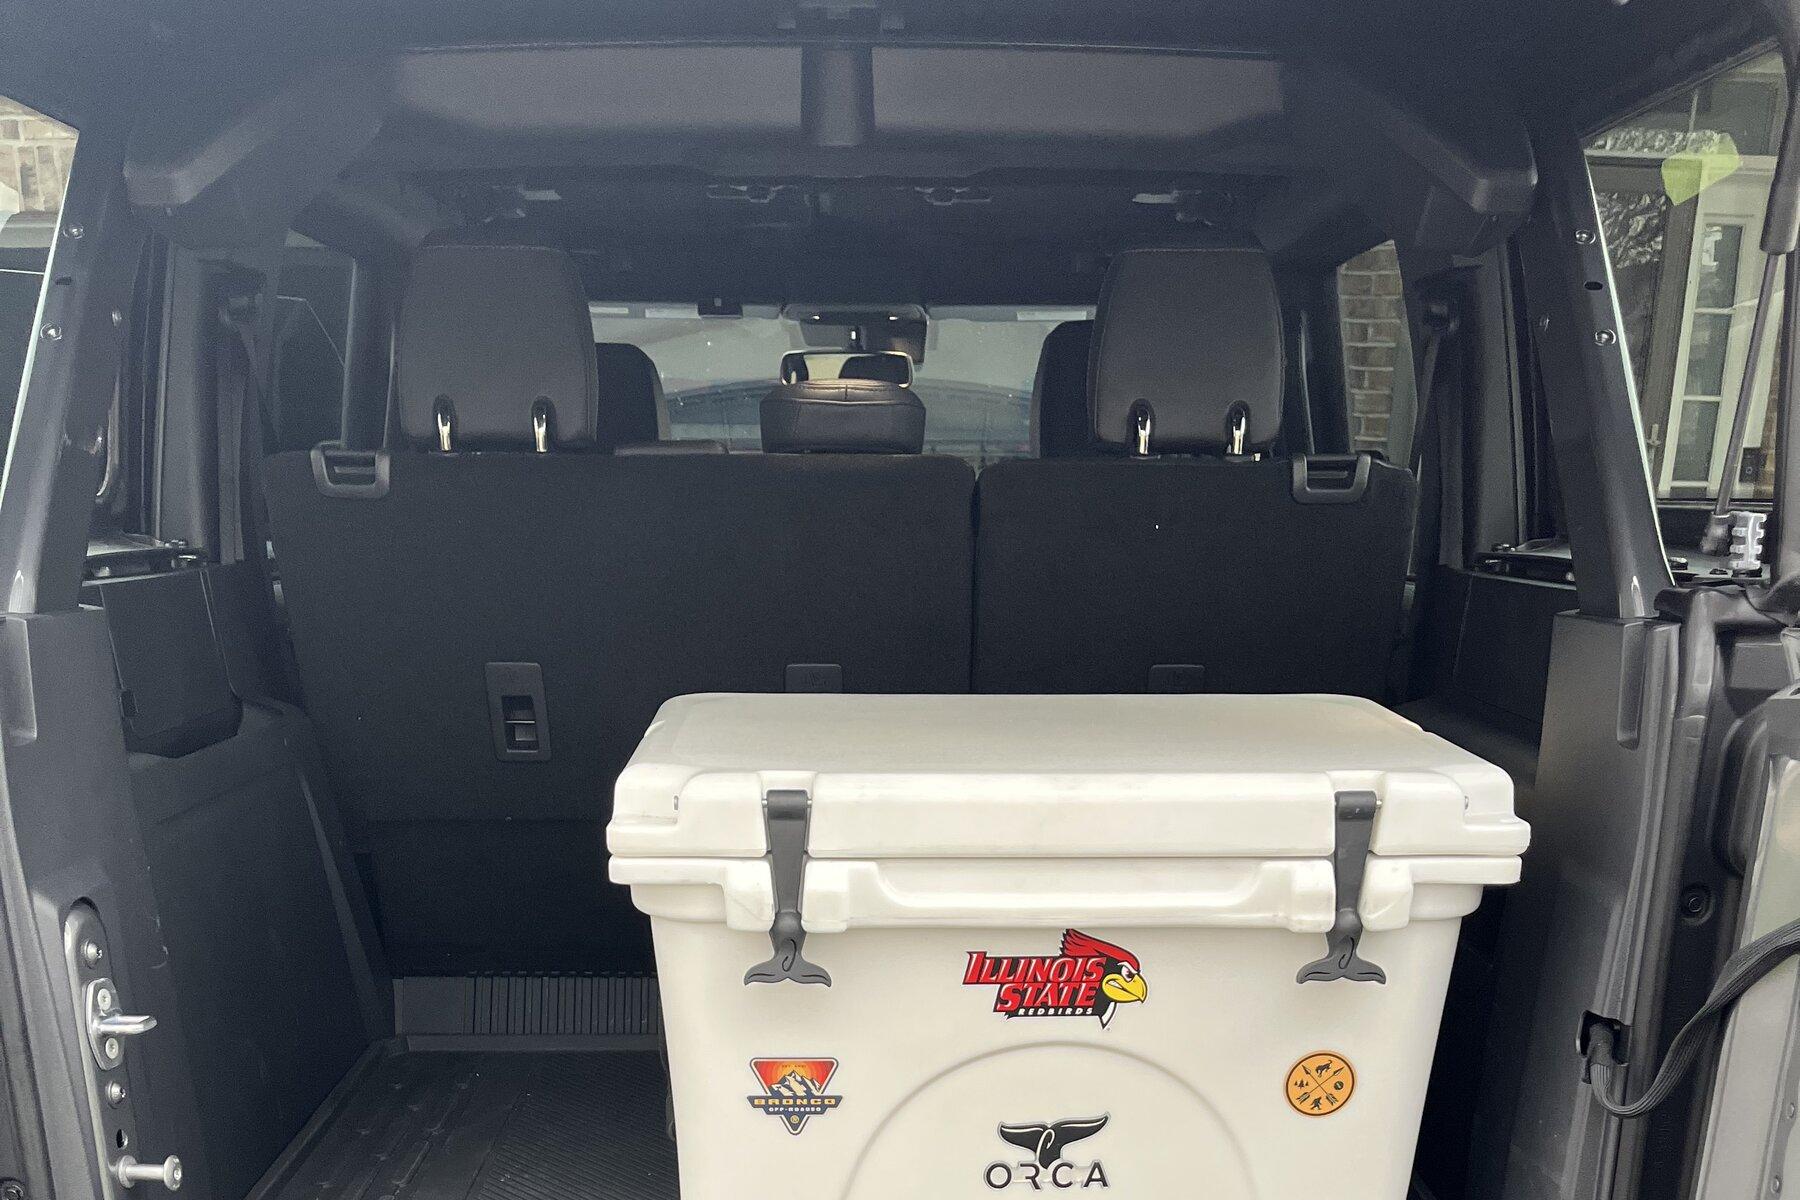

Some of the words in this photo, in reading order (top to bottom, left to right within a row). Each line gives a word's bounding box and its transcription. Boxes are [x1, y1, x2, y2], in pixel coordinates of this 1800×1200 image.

[963, 951, 1107, 984] ILLINOIS
[995, 982, 1100, 1011] STATE
[1018, 1007, 1093, 1016] REDBIRDS
[985, 1161, 1109, 1190] ORCA
